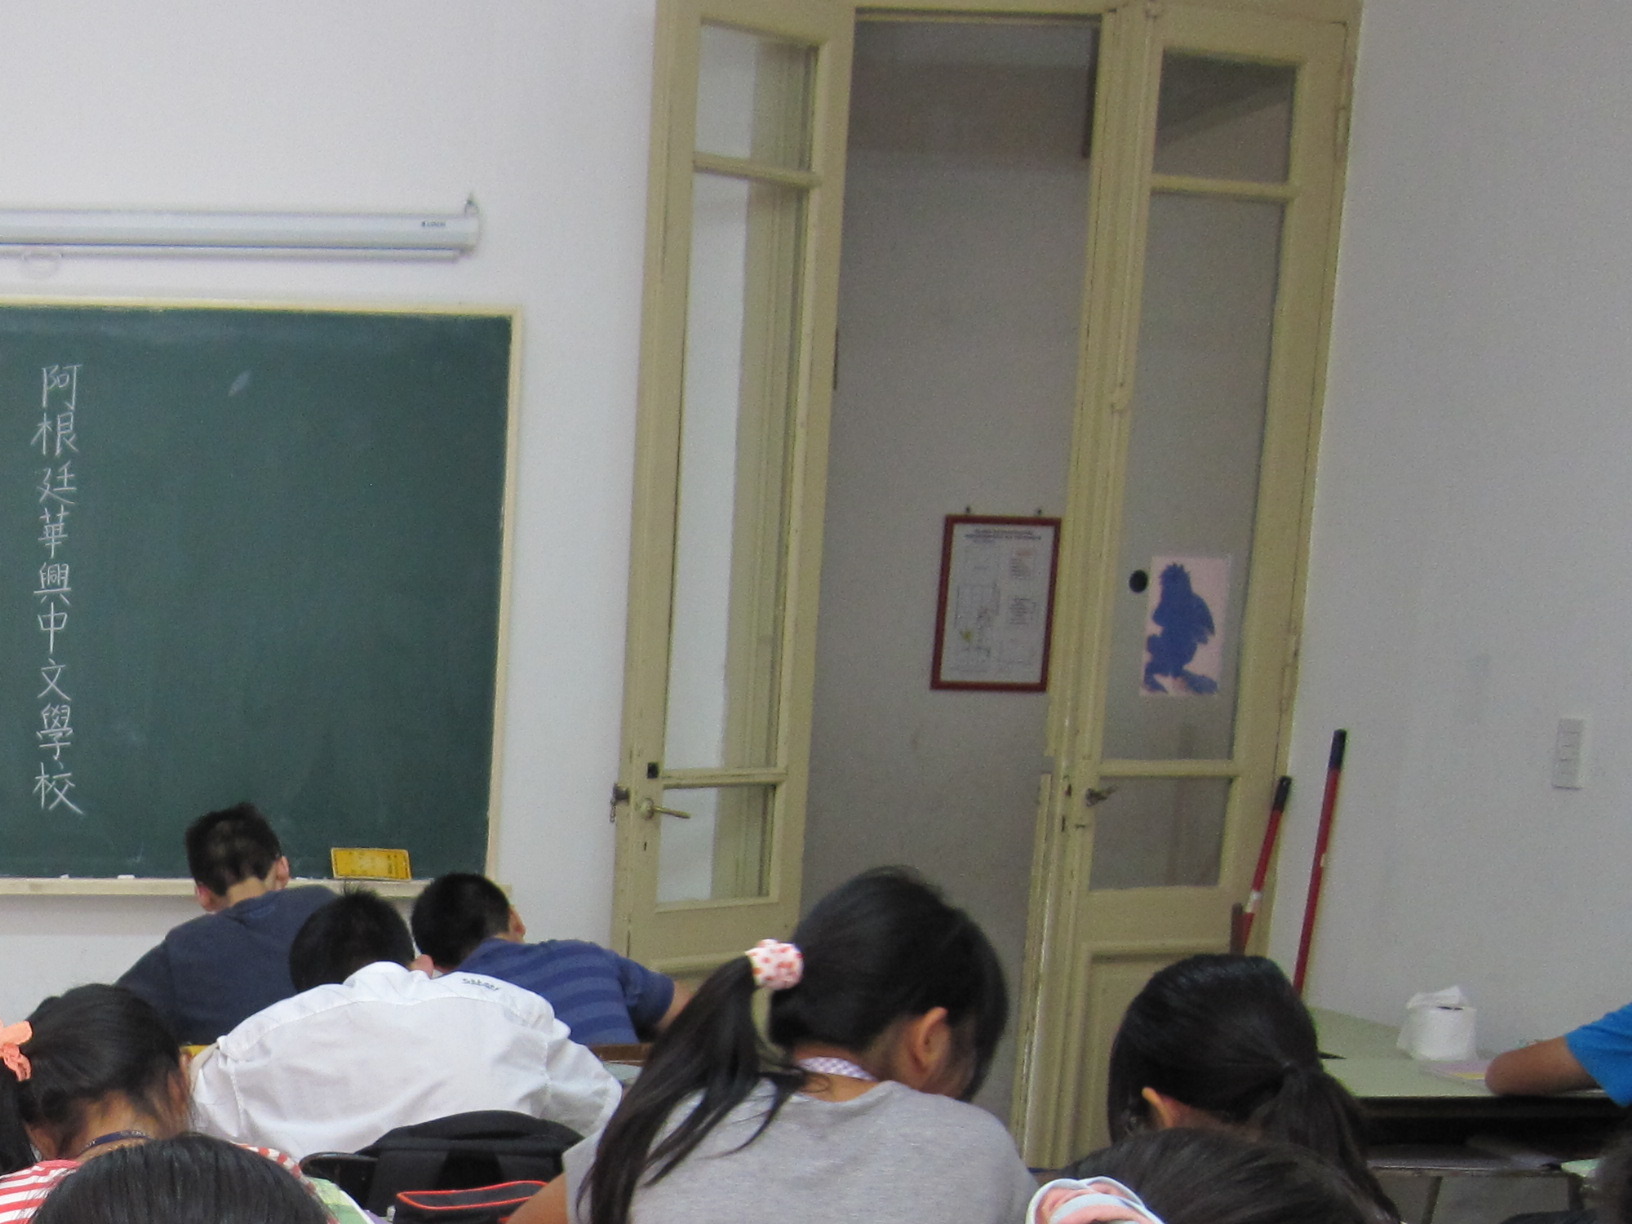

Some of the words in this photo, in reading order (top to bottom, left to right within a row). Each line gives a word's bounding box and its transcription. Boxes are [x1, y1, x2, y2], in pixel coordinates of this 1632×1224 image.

[30, 363, 84, 815] 阿根廷華興中文學校
